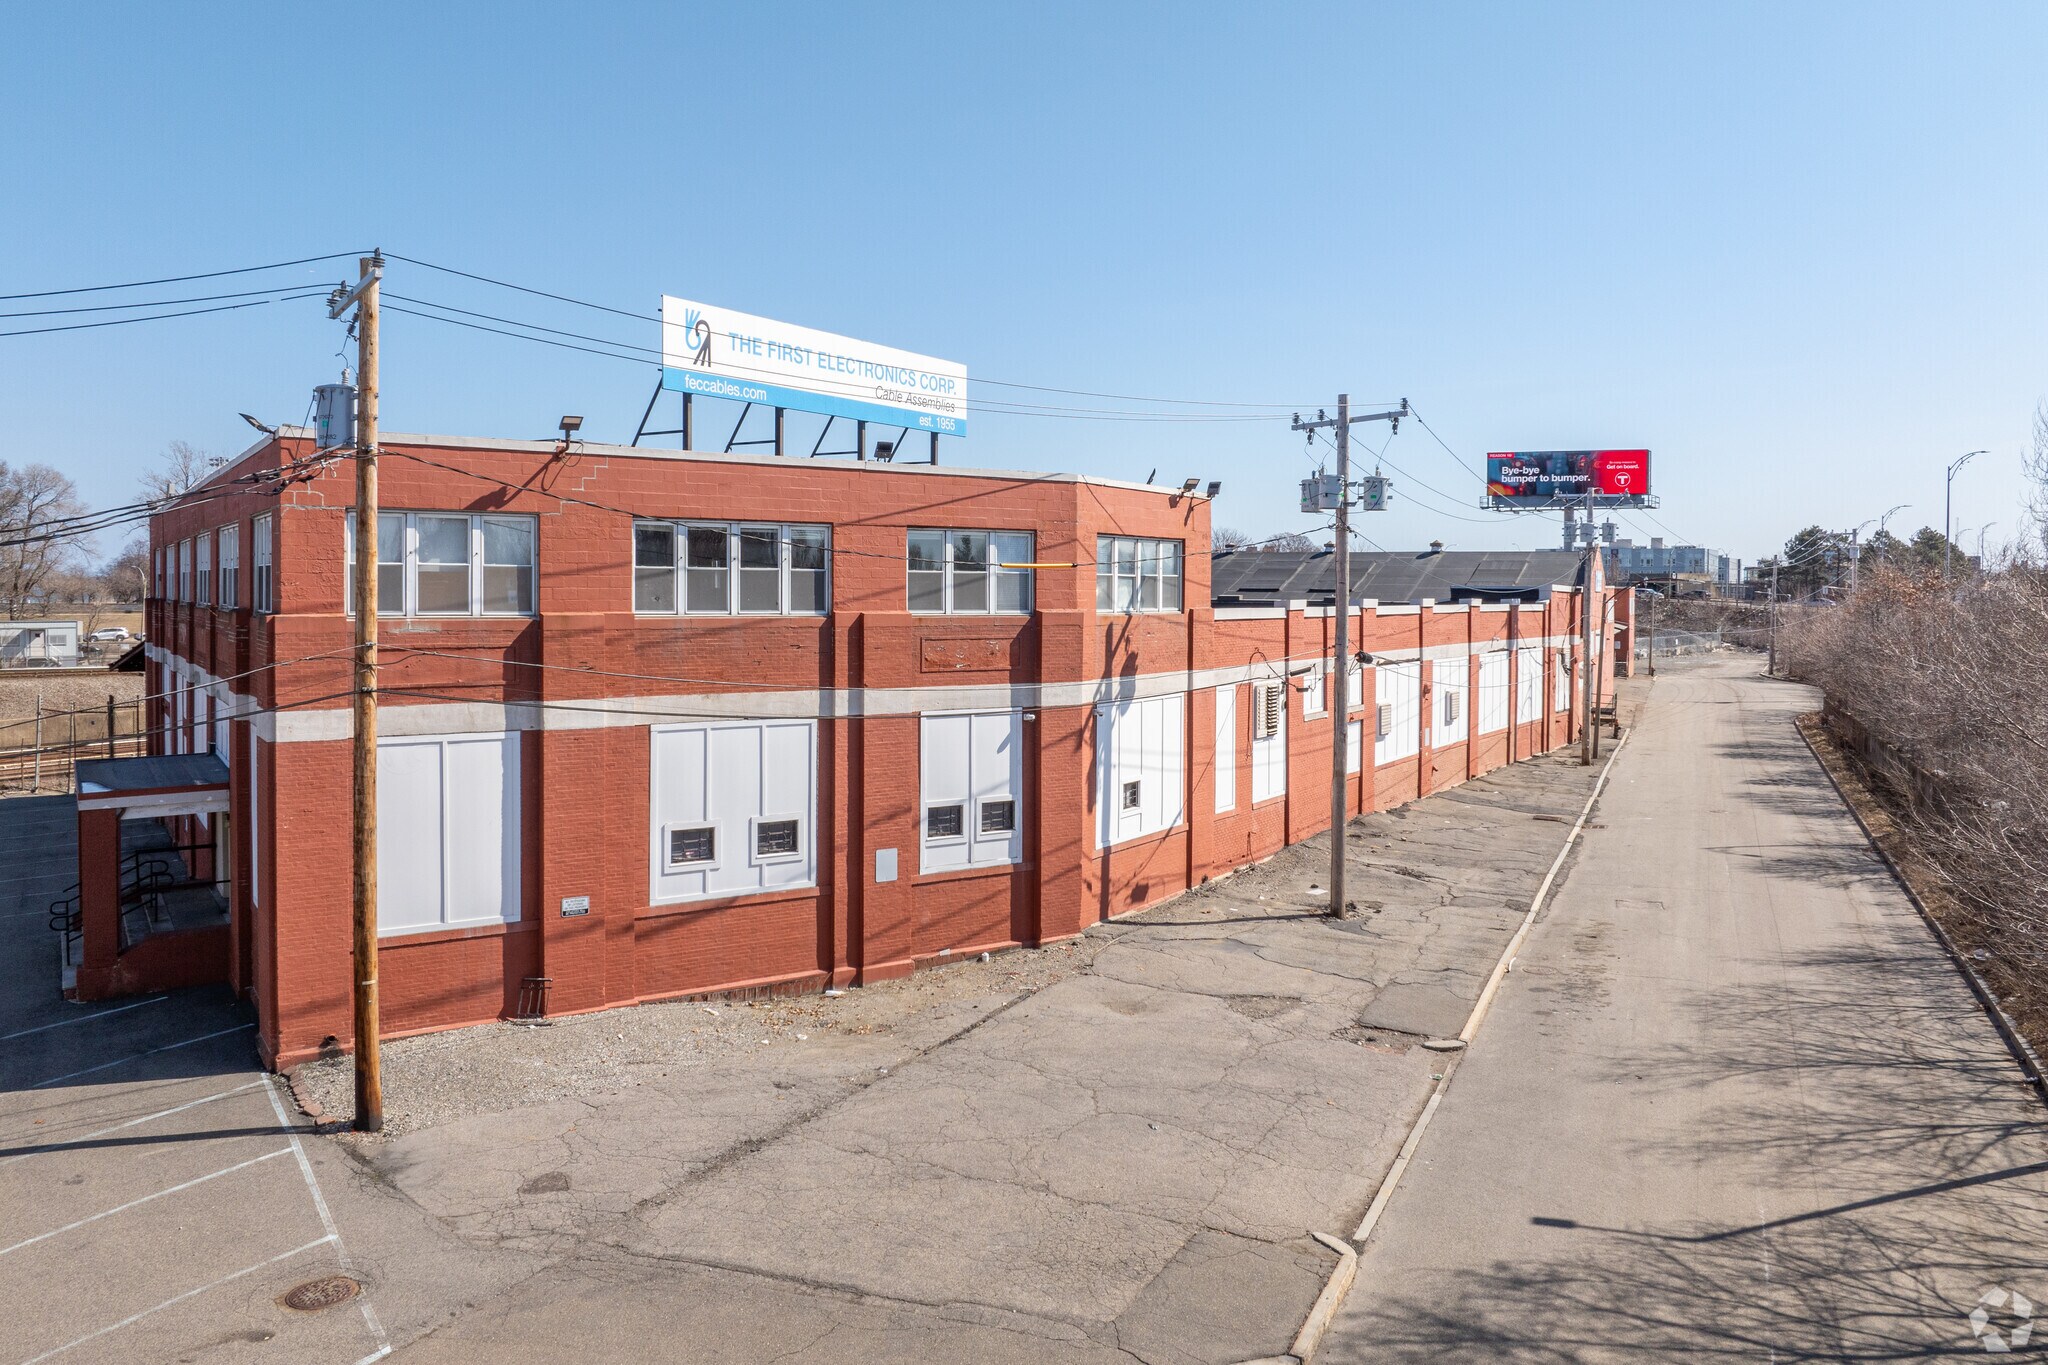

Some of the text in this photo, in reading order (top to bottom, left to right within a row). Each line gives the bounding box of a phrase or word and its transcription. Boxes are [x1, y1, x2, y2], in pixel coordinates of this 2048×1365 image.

[728, 332, 957, 395] THE FIRST ELECTRONICS CORP.
[684, 374, 767, 401] feccables.com
[875, 385, 956, 413] Cable Assemblies
[919, 416, 956, 431] est. 1955
[1501, 466, 1540, 476] Bye-bye
[1501, 474, 1591, 484] bumper to bumper.
